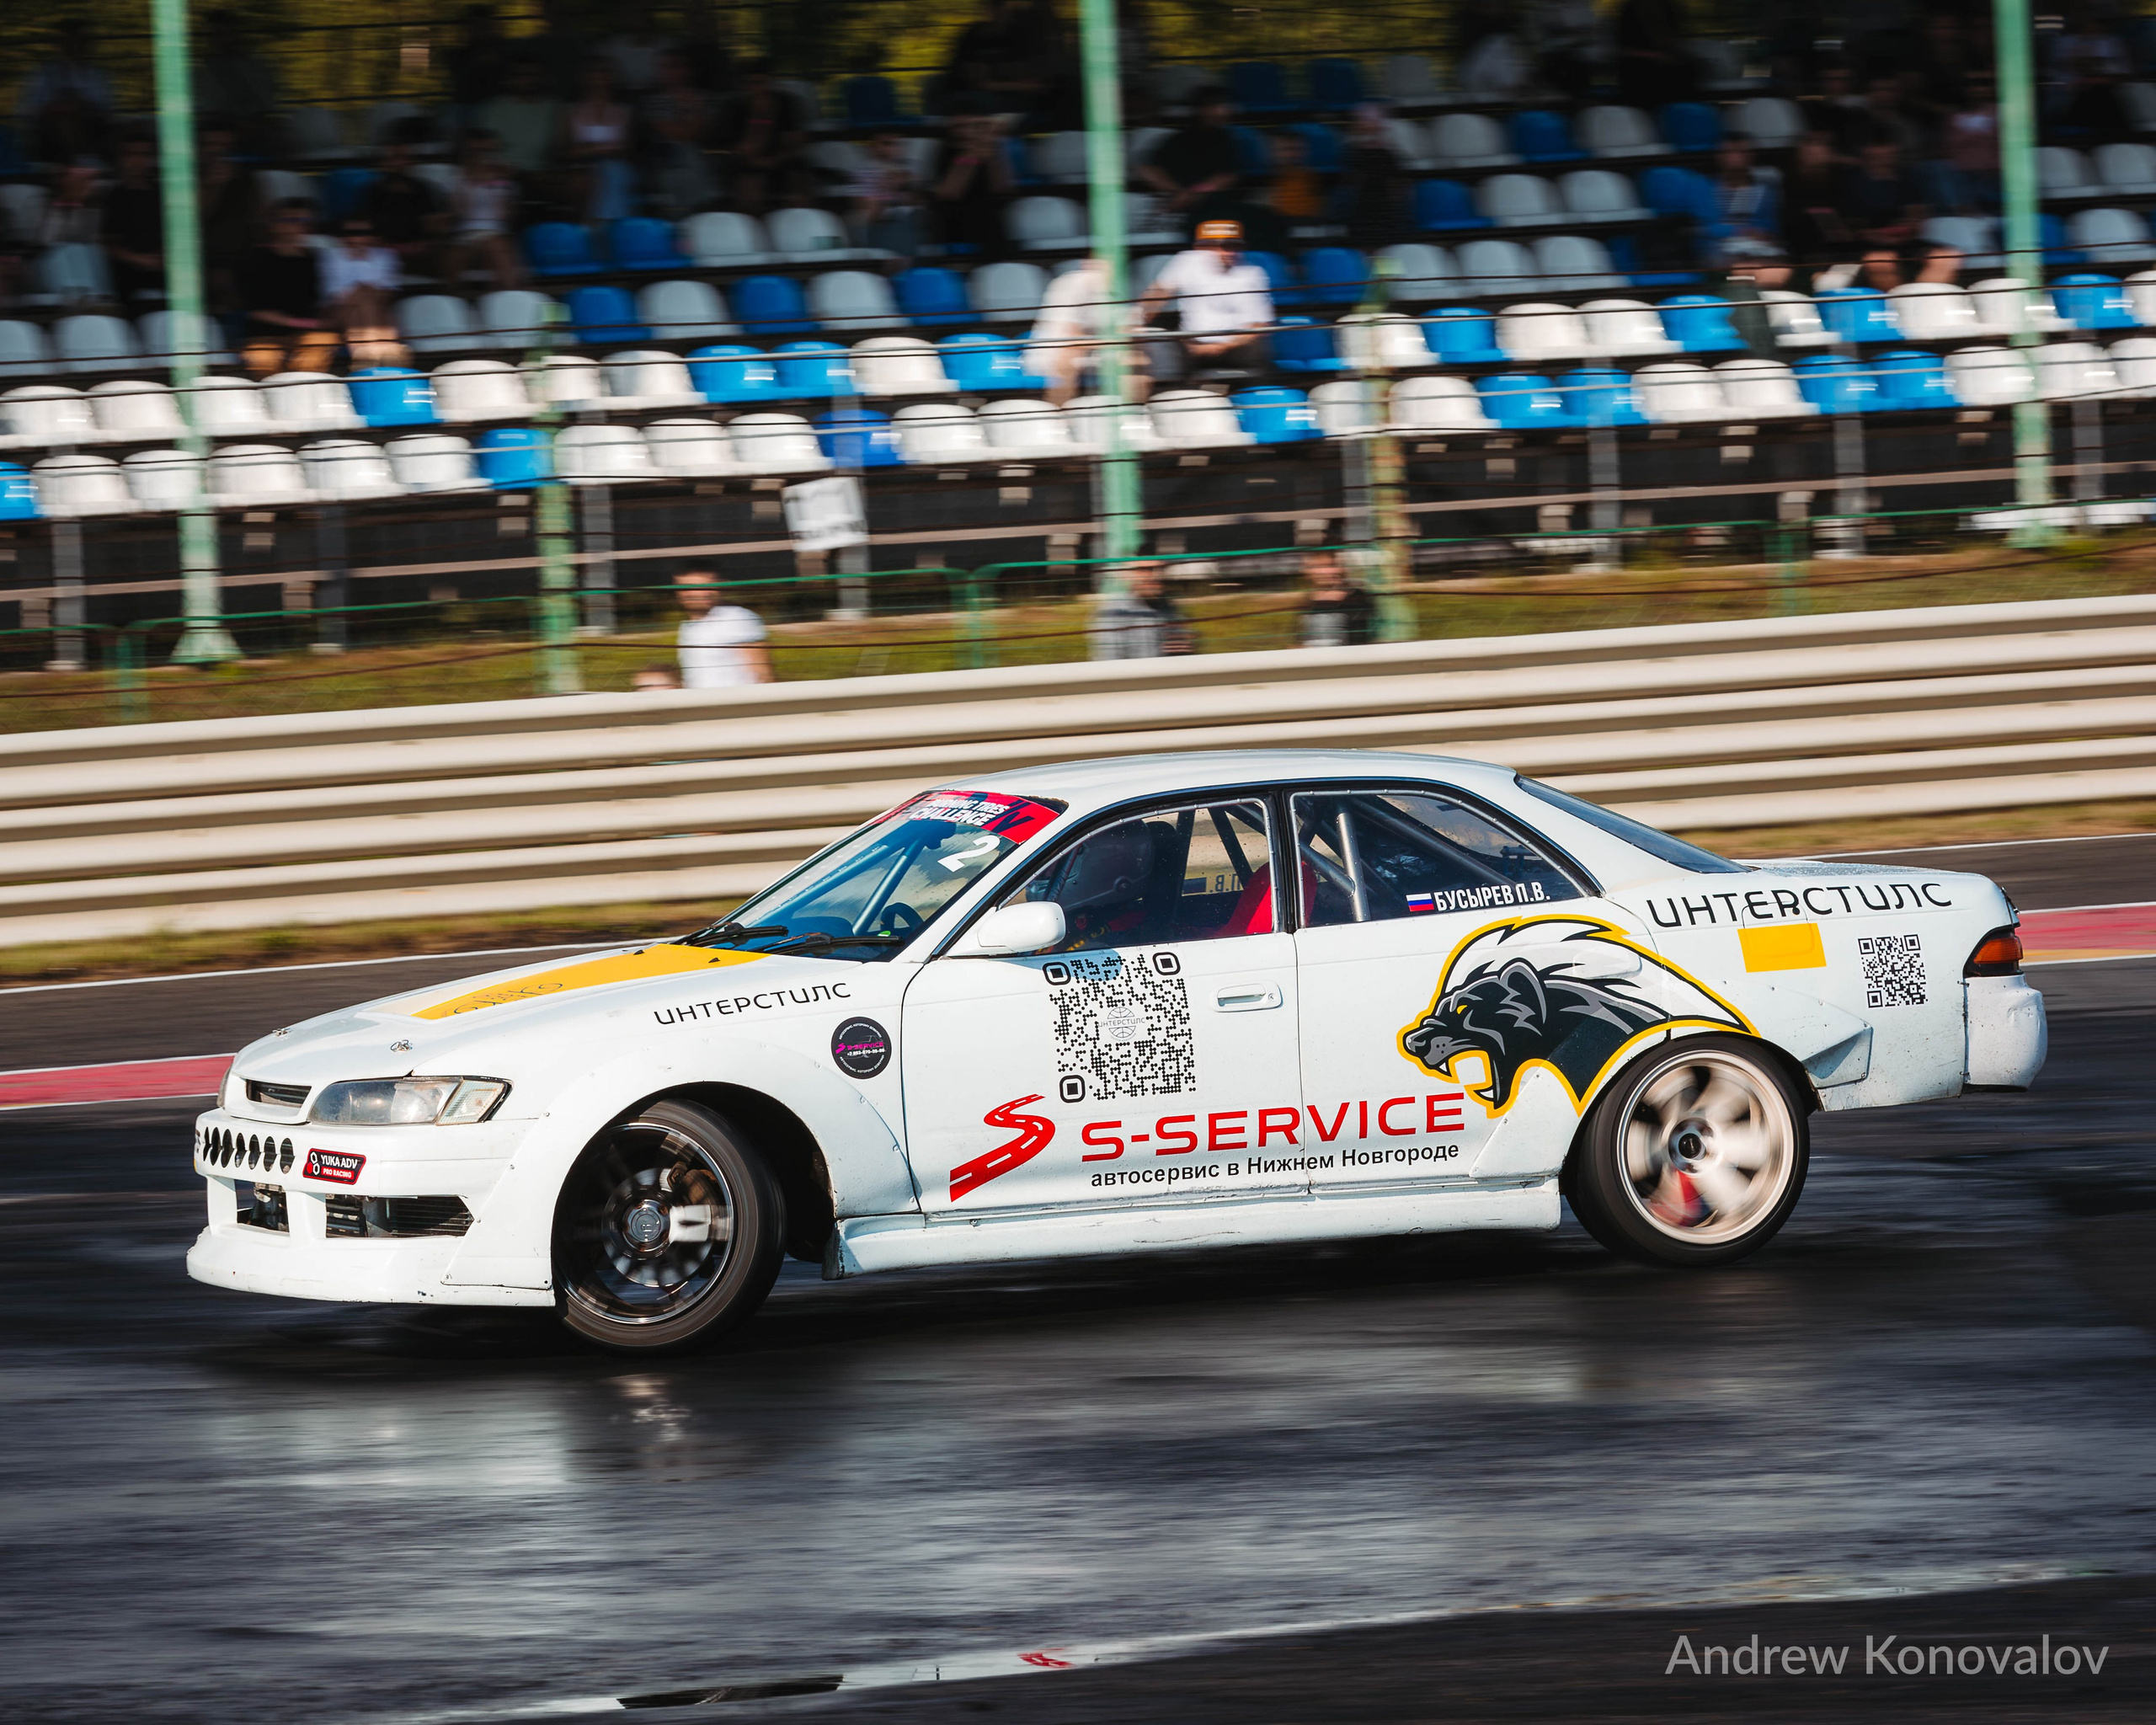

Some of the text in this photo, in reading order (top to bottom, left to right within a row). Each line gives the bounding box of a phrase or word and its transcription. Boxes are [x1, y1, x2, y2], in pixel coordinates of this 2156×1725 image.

[910, 807, 996, 826] CHALLENGE
[974, 802, 1010, 814] TIRES
[937, 835, 1000, 873] 2
[1433, 881, 1550, 911] БУСЫРЕВ П.В.
[1081, 1092, 1465, 1162] S-SERVICE
[321, 1154, 358, 1169] YUKA ADV
[333, 1169, 352, 1178] RACING
[1091, 1145, 1460, 1187] автосервис в Нижнем Новгороде
